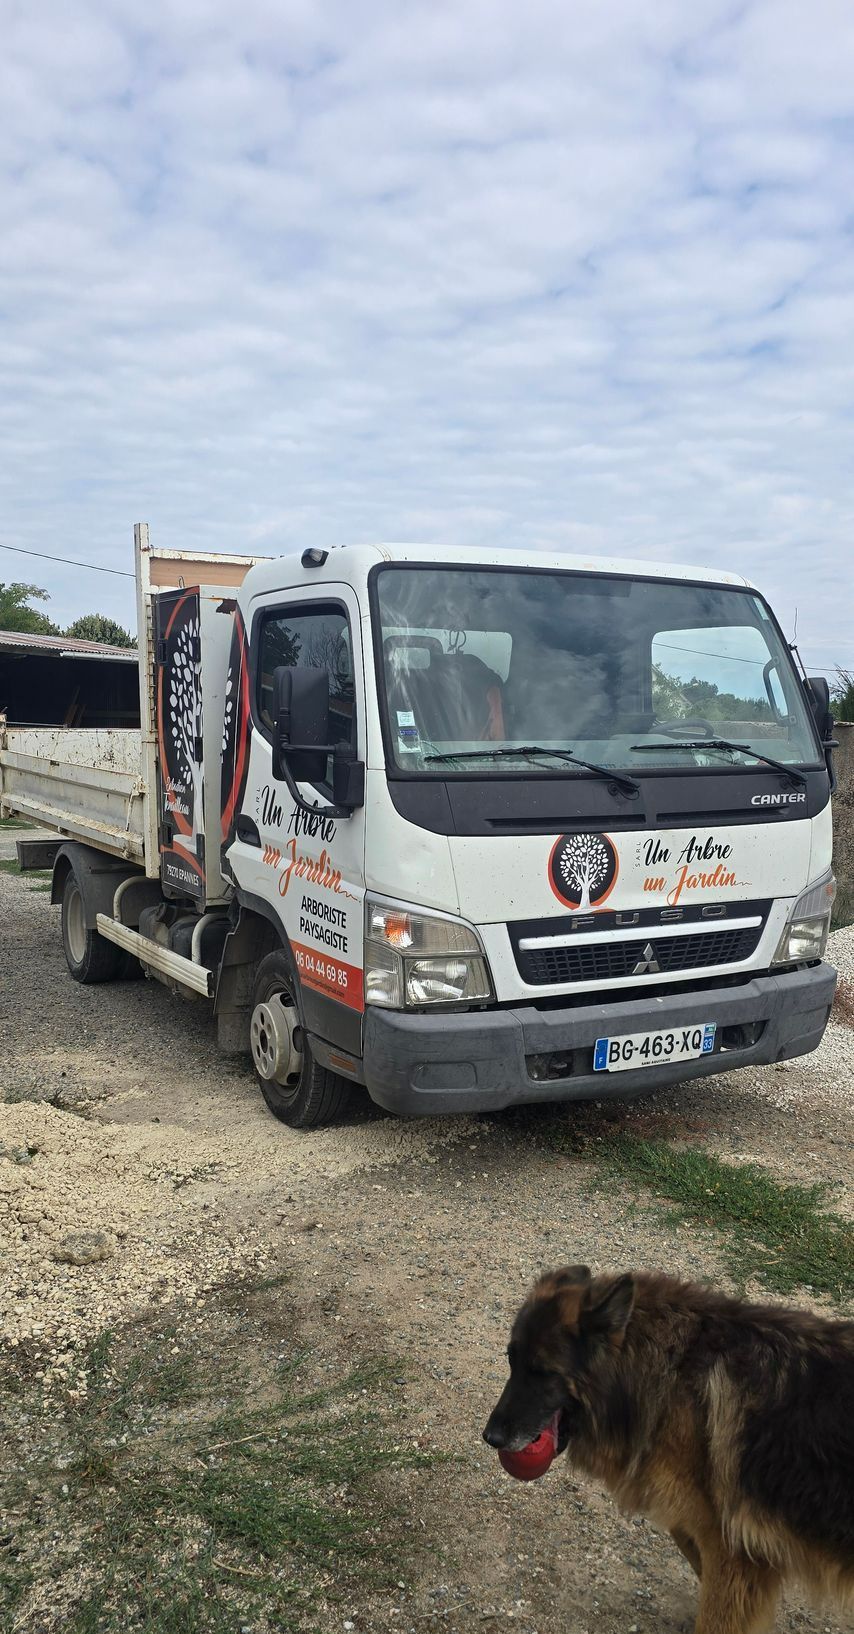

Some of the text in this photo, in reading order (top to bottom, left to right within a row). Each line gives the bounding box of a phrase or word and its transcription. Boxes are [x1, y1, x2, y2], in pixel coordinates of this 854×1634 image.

[261, 784, 284, 827] Un
[751, 793, 806, 806] CANTER
[262, 837, 346, 897] un Jardin
[643, 835, 733, 867] Un Arbre
[178, 868, 199, 887] EPANNES
[643, 863, 737, 907] un Jardin
[301, 895, 347, 929] ARBORISTE
[571, 905, 726, 929] FUSO
[299, 916, 348, 953] PAYSAGISTE
[295, 950, 304, 967] 06
[305, 954, 315, 972] 04
[316, 959, 325, 977] 44
[326, 964, 336, 982] 69
[337, 969, 348, 987] 85
[608, 1029, 703, 1064] BG-463-XQ
[703, 1038, 713, 1049] 33
